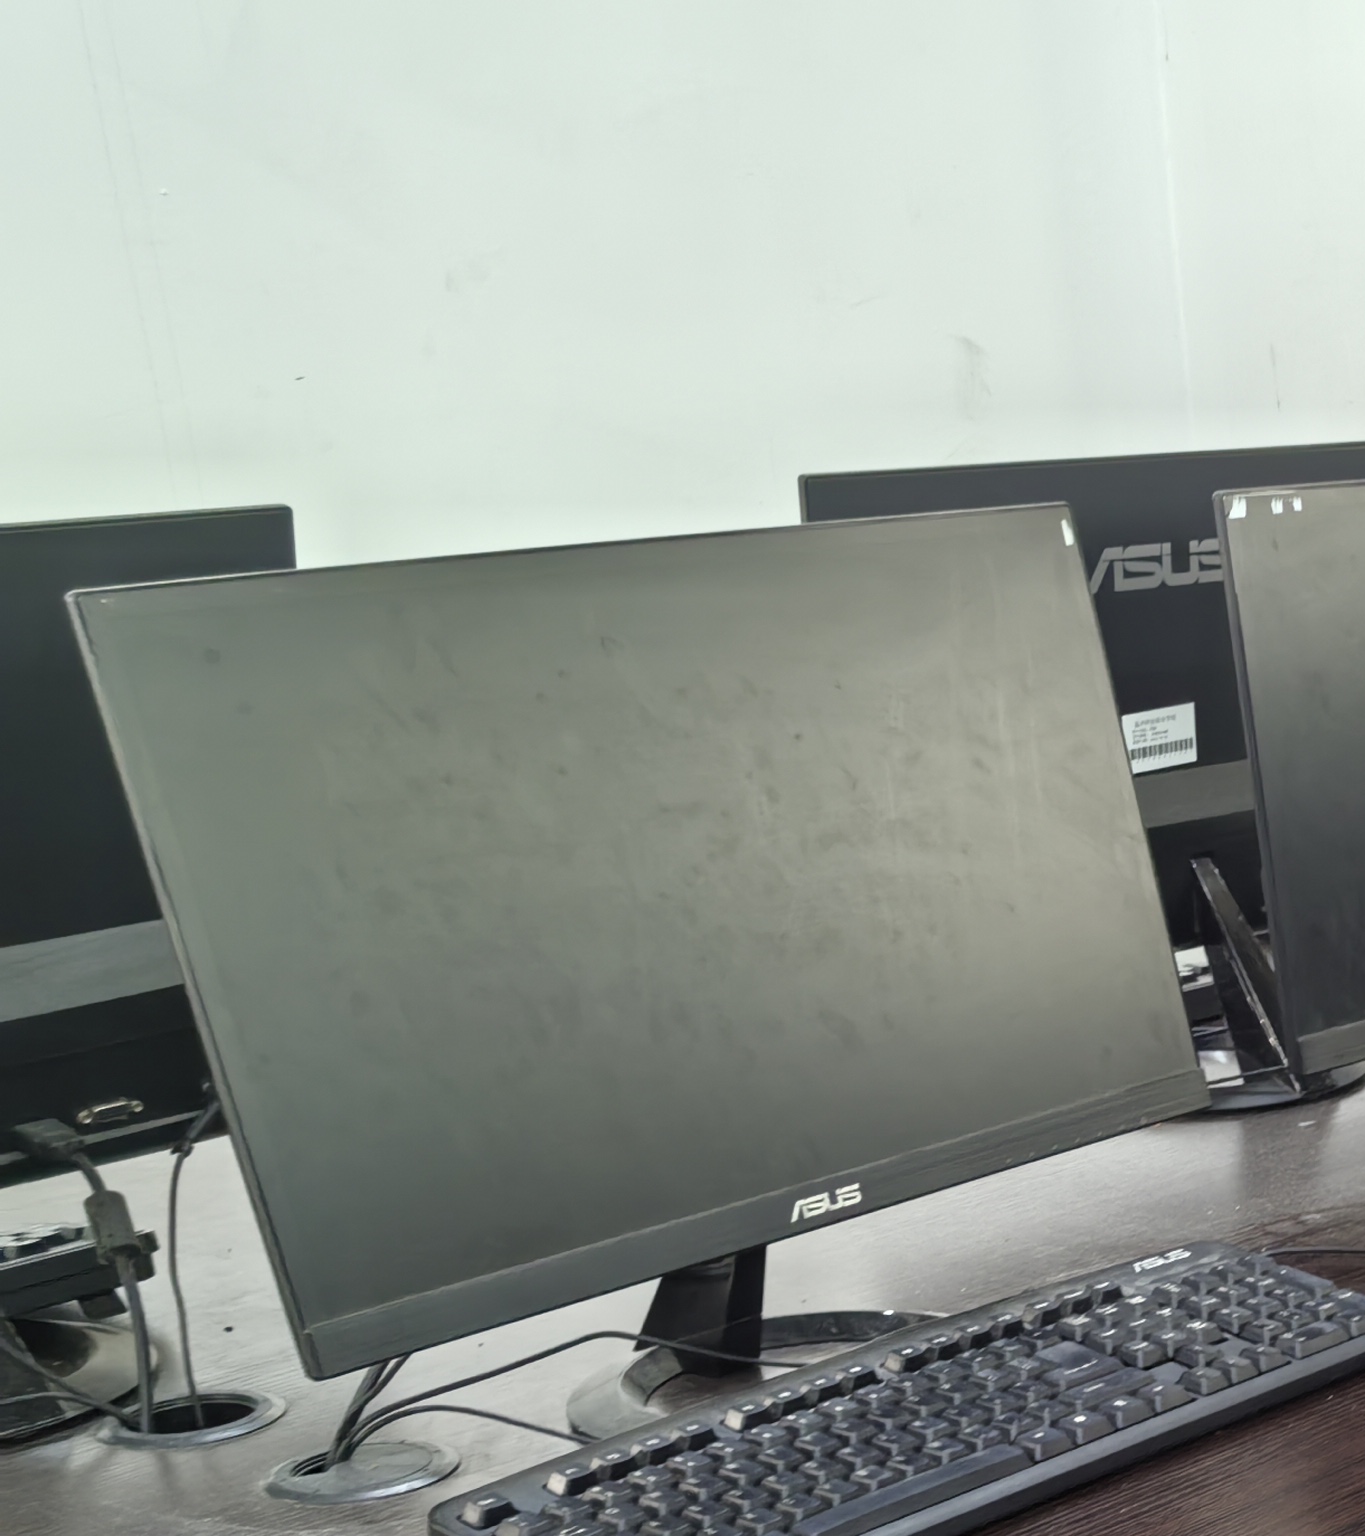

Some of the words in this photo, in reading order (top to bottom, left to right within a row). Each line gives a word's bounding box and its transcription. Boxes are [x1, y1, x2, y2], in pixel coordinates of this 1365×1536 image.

[1089, 537, 1224, 595] ASUS
[790, 1183, 862, 1223] ASUS
[1132, 1248, 1192, 1273] ASUS
